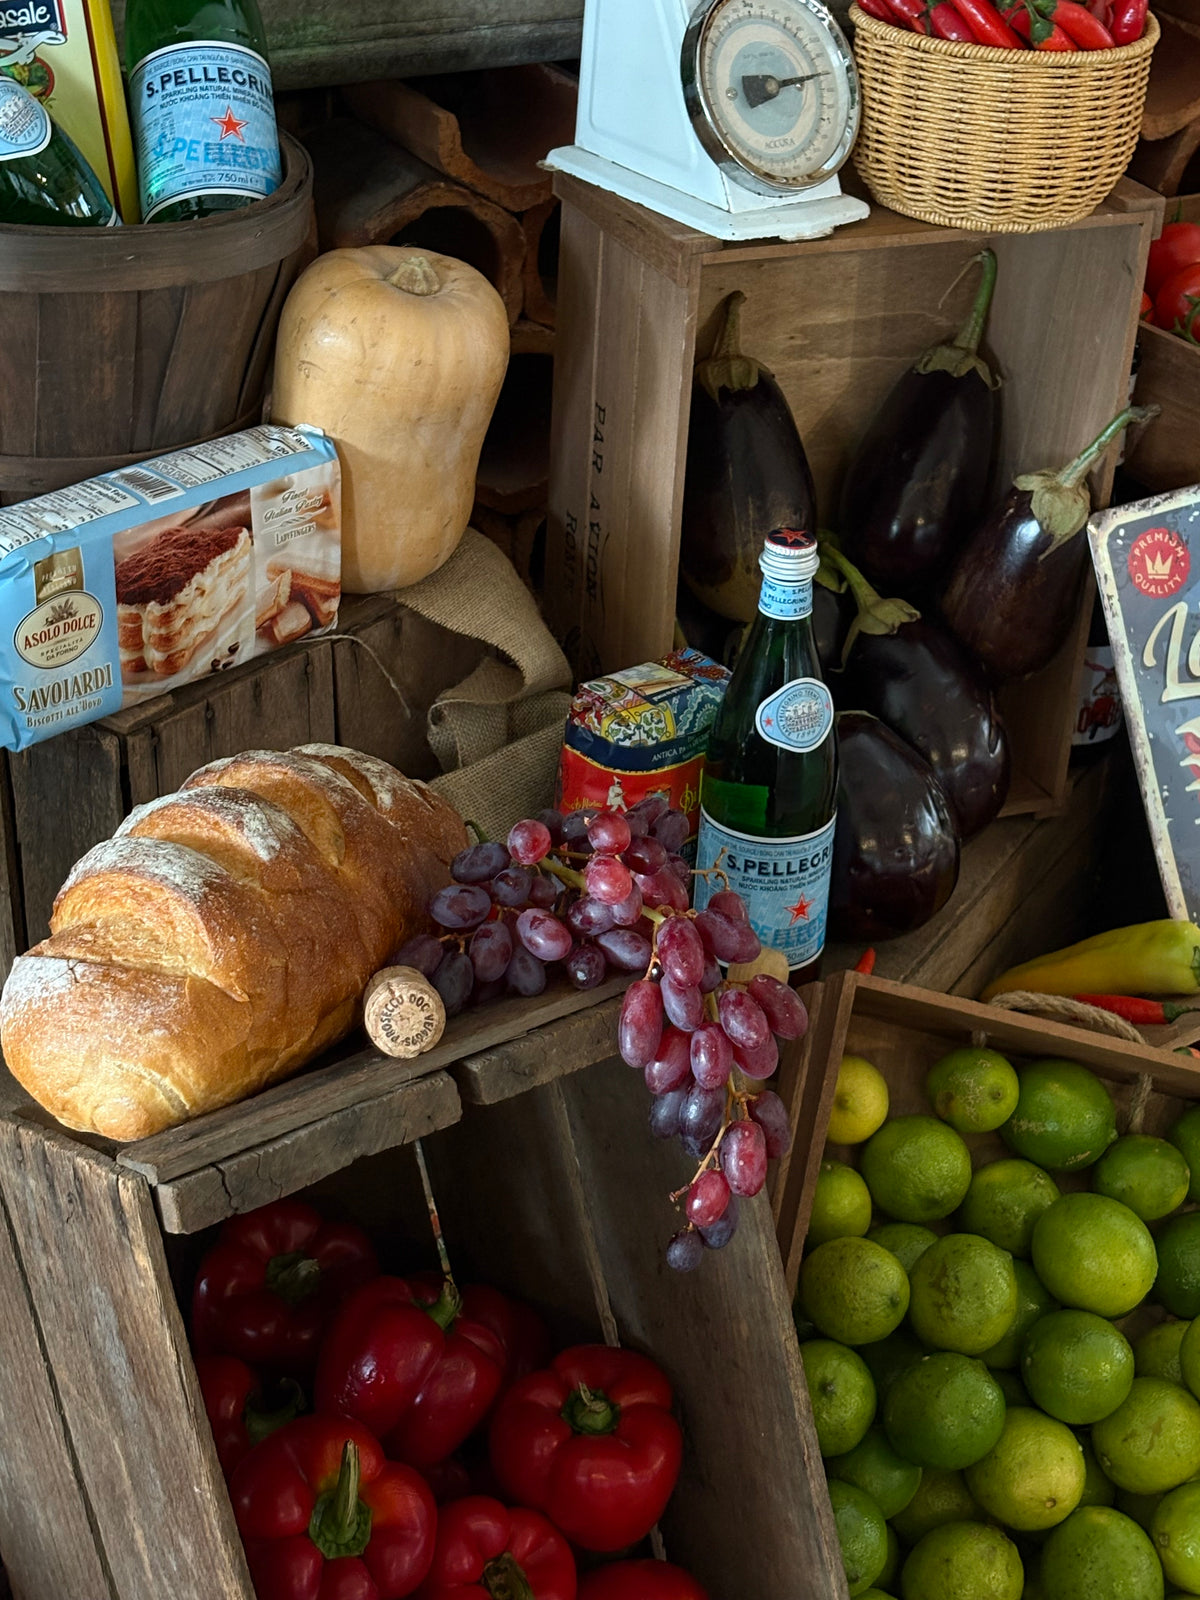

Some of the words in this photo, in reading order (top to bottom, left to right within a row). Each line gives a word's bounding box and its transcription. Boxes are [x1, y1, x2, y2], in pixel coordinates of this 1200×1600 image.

[160, 85, 199, 101] SPARKLING
[200, 84, 232, 93] NATURAL
[593, 401, 606, 475] PAR
[264, 506, 293, 522] Italian
[295, 494, 324, 512] Pastry
[1134, 532, 1185, 558] PREMIUM
[1135, 573, 1182, 594] QUALITY
[23, 624, 61, 651] ASOLO
[64, 613, 97, 632] DOLCE
[46, 652, 56, 662] DA
[56, 645, 79, 659] FORNO
[1143, 601, 1200, 703] L
[13, 664, 113, 713] SAVOIARDI
[652, 747, 678, 762] ANTICA
[741, 875, 779, 885] SPARKLING
[780, 875, 807, 885] NATURAL
[408, 993, 430, 1012] DOC
